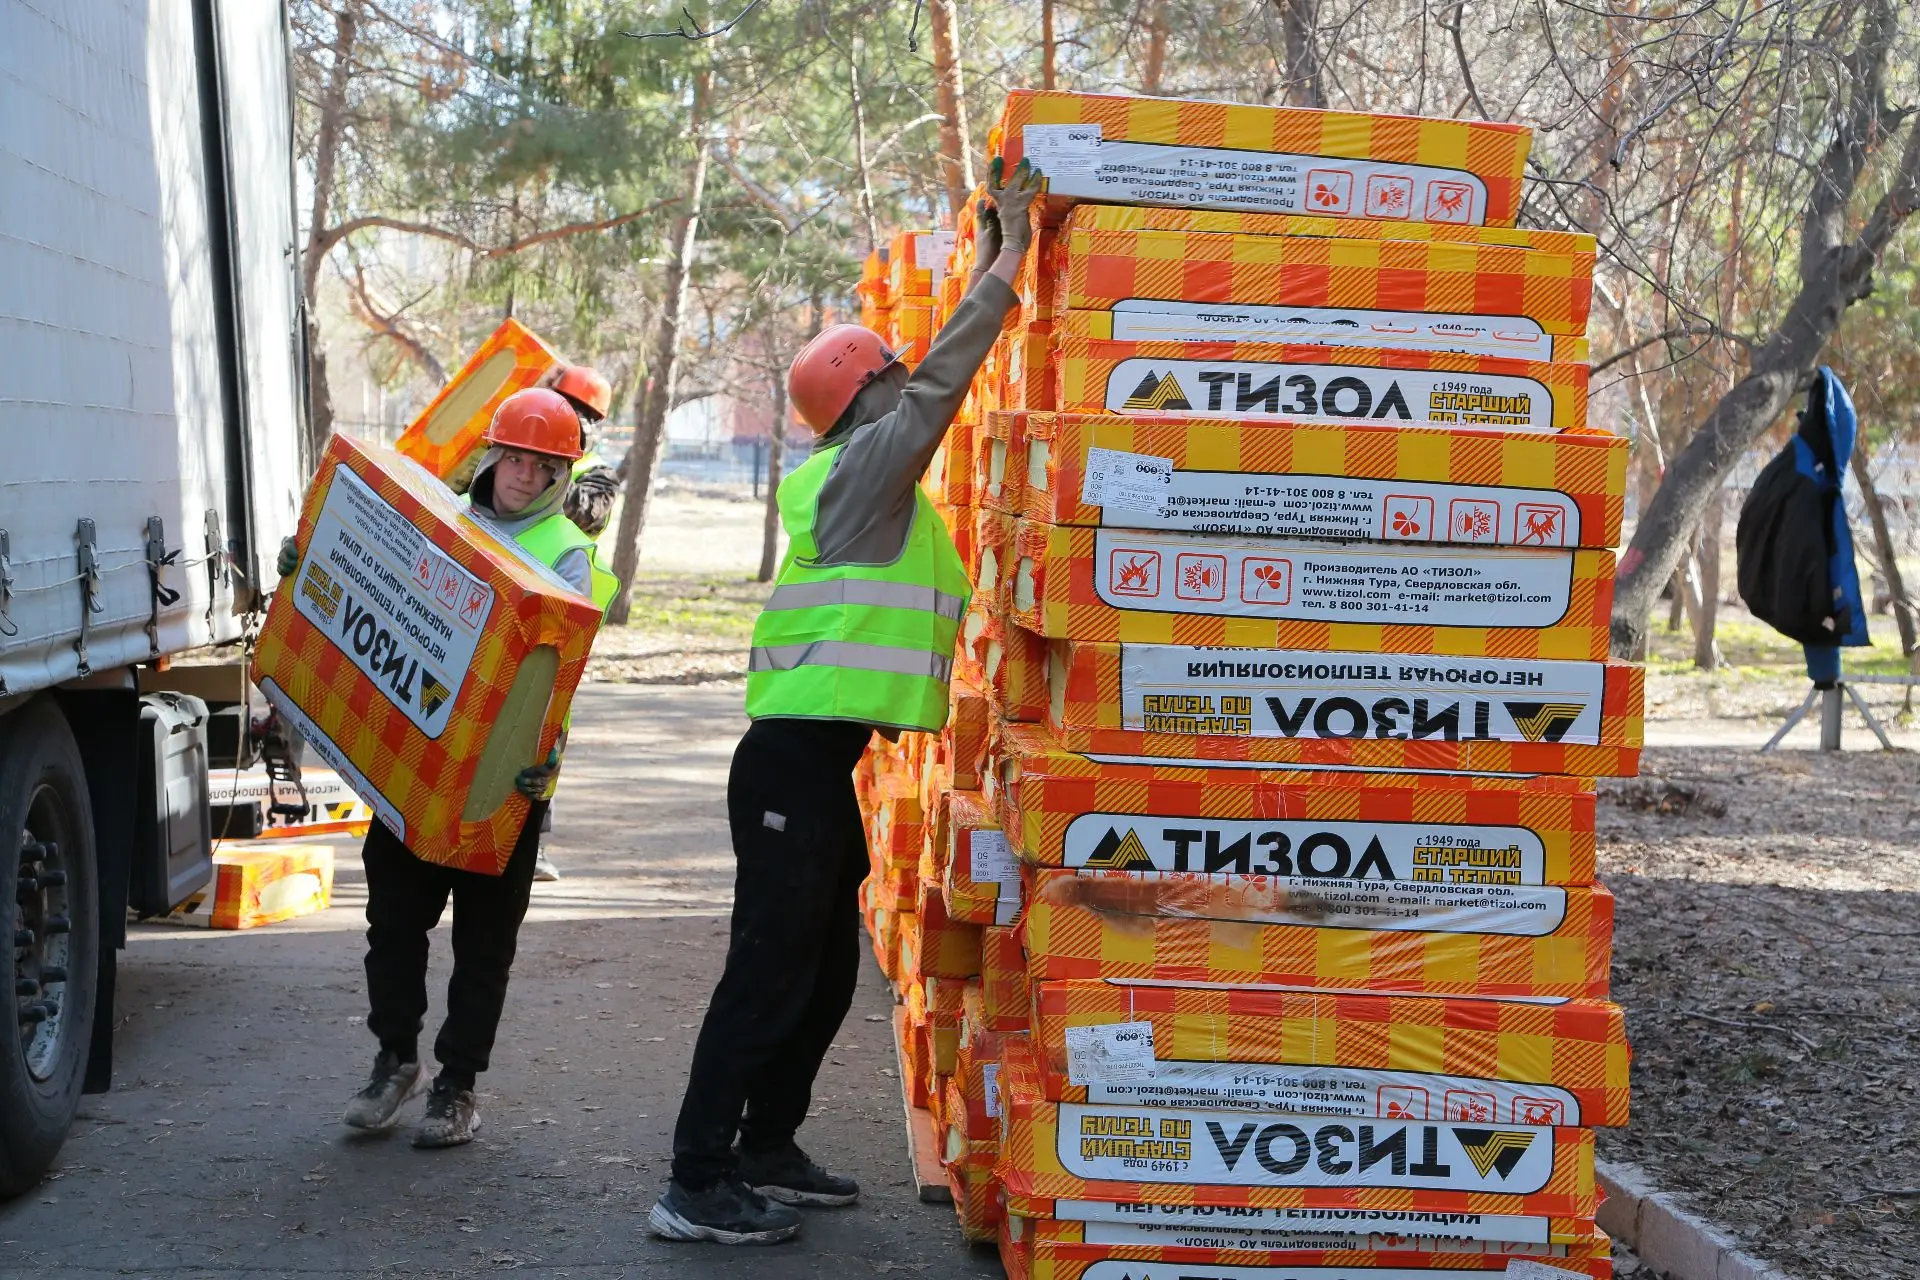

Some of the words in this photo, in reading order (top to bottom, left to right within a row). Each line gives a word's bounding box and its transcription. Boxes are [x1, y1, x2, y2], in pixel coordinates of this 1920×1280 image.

[1180, 158, 1239, 170] 301-41-14
[1242, 162, 1261, 172] 800
[1265, 164, 1273, 173] 8
[1277, 163, 1298, 173] тел.
[1170, 169, 1208, 180] e-mail:
[1214, 171, 1297, 184] www.tizol.com
[1122, 177, 1202, 191] Свердловская
[1206, 181, 1235, 193] Тура,
[1238, 184, 1284, 195] Нижняя
[1131, 189, 1184, 202] «ТИЗОЛ»
[1189, 193, 1204, 202] АО
[1207, 194, 1294, 209] Производитель
[1441, 381, 1467, 393] 1949
[1470, 385, 1494, 396] года
[1198, 371, 1413, 420] ТИЗОЛ
[1430, 391, 1531, 414] СТАРШИЙ
[1245, 486, 1308, 497] 301-41-14
[1312, 489, 1335, 498] 800
[1338, 491, 1345, 499] 8
[1350, 491, 1373, 500] тел.
[1234, 498, 1276, 508] e-mail:
[1284, 501, 1372, 513] www.tizol.com
[1182, 509, 1269, 522] Свердловская
[1274, 512, 1305, 524] Тура,
[1309, 514, 1358, 526] Нижняя
[1362, 517, 1371, 525] г.
[1255, 525, 1273, 535] АО
[1276, 525, 1371, 539] Производитель
[337, 528, 362, 557] ШУМА
[360, 550, 373, 568] ОТ
[1304, 562, 1397, 576] Производитель
[1401, 567, 1418, 575] АО
[1423, 567, 1481, 578] «ТИЗОЛ»
[329, 546, 397, 616] ТЕПЛОИЗОЛЯЦИЯ
[372, 559, 407, 599] ЗАЩИТА
[1303, 576, 1312, 584] г.
[1316, 575, 1364, 586] Нижняя
[1369, 577, 1400, 590] Тура,
[1404, 579, 1491, 592] Свердловская
[1495, 580, 1520, 590] обл.
[1302, 587, 1391, 600] www.tizol.com
[1398, 591, 1440, 602] e-mail:
[1444, 592, 1552, 604] market@tizol.com
[1301, 600, 1325, 609] тел.
[1329, 600, 1336, 609] 8
[1340, 601, 1363, 611] 800
[1366, 602, 1429, 613] 301-41-14
[404, 590, 453, 641] НАДЕЖНАЯ
[394, 607, 446, 663] НЕГОРЮЧАЯ
[335, 593, 424, 705] ТИЗОЛ
[1187, 661, 1392, 682] ТЕПЛОИЗОЛЯЦИЯ
[1399, 666, 1544, 687] НЕГОРЮЧАЯ
[1143, 695, 1215, 715] ТЕПЛУ
[1221, 696, 1252, 716] ПО
[1265, 697, 1501, 741] ТИЗОЛ
[1424, 833, 1453, 846] 1949
[1455, 837, 1480, 849] года
[977, 852, 988, 860] 50
[1161, 827, 1397, 879] ТИЗОЛ
[1412, 845, 1521, 867] СТАРШИЙ
[1302, 877, 1352, 890] Нижняя
[1357, 880, 1390, 892] Тура,
[1394, 882, 1483, 896] Свердловская
[1488, 884, 1514, 895] обл.
[1289, 889, 1379, 903] www.tizol.com
[1388, 894, 1430, 906] e-mail:
[1435, 897, 1546, 911] market@tizol.com
[1327, 905, 1350, 915] 800
[1234, 1075, 1299, 1088] 301-41-14
[1302, 1079, 1327, 1090] 800
[1329, 1080, 1338, 1090] 8
[1341, 1080, 1367, 1090] тел.
[1107, 1085, 1220, 1098] market@tizol.com
[1224, 1087, 1267, 1099] e-mail:
[1273, 1089, 1366, 1103] www.tizol.com
[1170, 1098, 1261, 1112] Свердловская
[1265, 1101, 1297, 1115] Тура,
[1300, 1104, 1353, 1116] Нижняя
[1080, 1115, 1154, 1138] ТЕПЛУ
[1160, 1119, 1191, 1139] ПО
[1080, 1138, 1191, 1161] СТАРШИЙ
[1205, 1121, 1451, 1178] ТИЗОЛ
[1123, 1158, 1148, 1169] года
[1152, 1160, 1179, 1172] 1949
[1175, 1237, 1236, 1249] «ТИЗОЛ»
[1239, 1239, 1257, 1249] АО
[1261, 1238, 1357, 1250] Производитель
